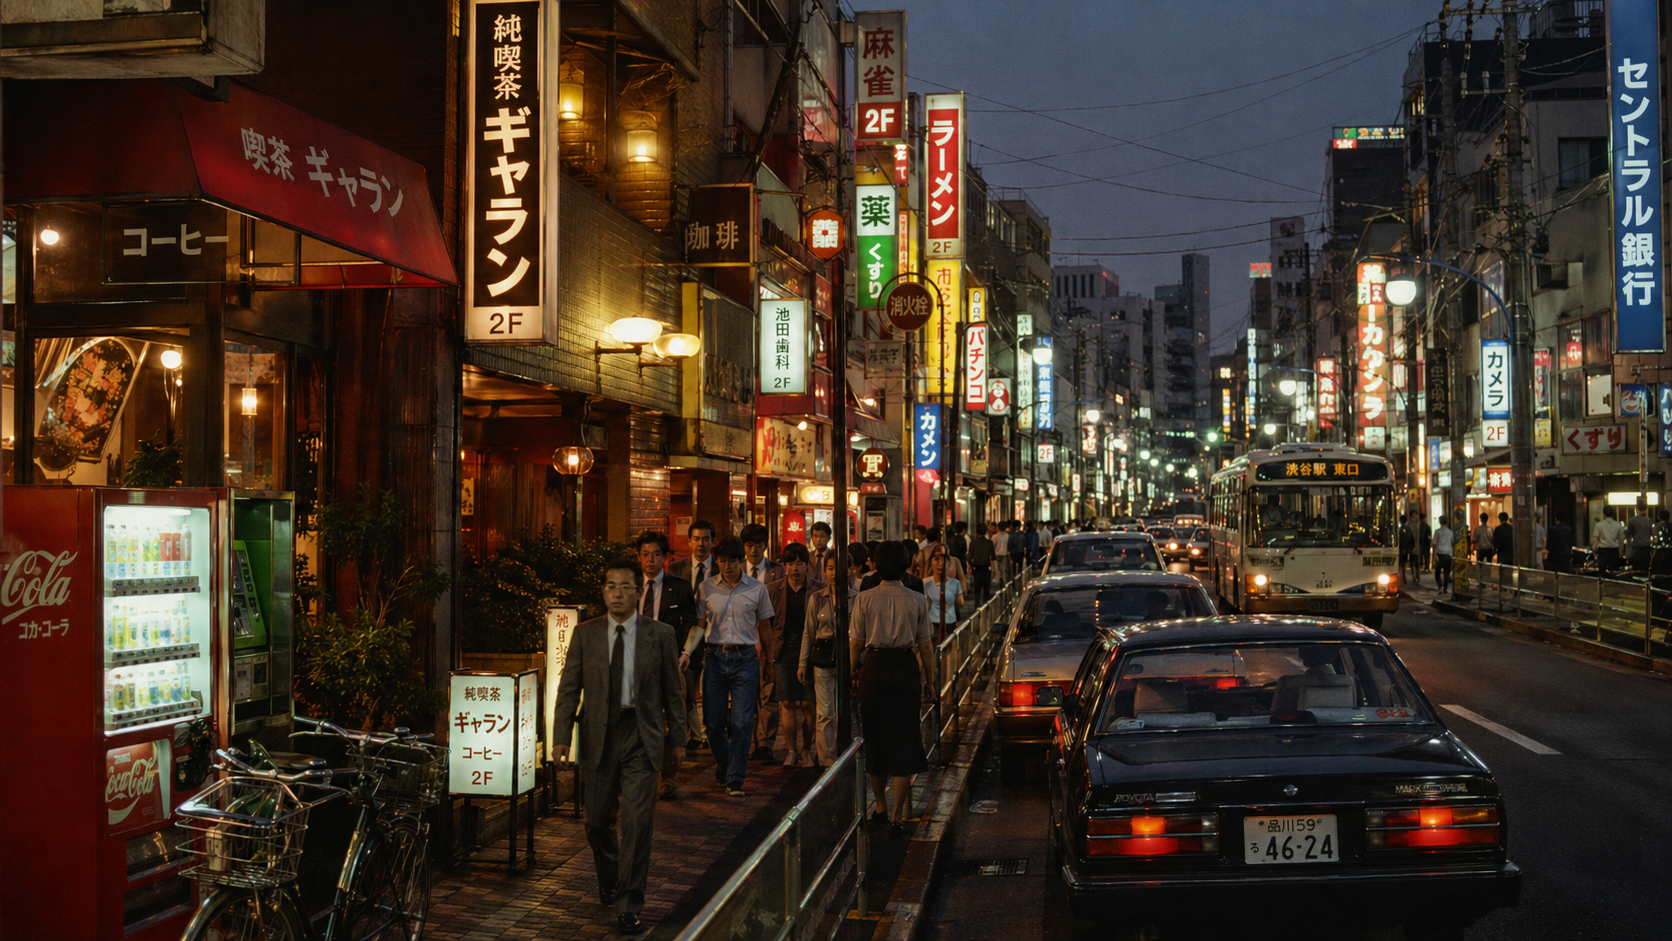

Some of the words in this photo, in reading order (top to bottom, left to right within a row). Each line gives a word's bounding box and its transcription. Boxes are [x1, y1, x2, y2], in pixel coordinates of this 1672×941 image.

[493, 14, 523, 100] 純喫茶
[862, 27, 895, 97] 麻雀
[865, 108, 895, 133] 2F
[241, 127, 295, 182] 喫茶
[305, 145, 403, 217] ギャラン
[931, 120, 955, 226] ラーメン
[1618, 58, 1655, 306] セントラル銀行
[484, 106, 531, 297] ギャラン
[861, 195, 890, 227] 薬
[123, 224, 229, 256] コーヒー
[688, 221, 739, 250] 珈琲
[932, 242, 952, 253] 2F
[867, 243, 884, 299] くすり
[891, 295, 928, 316] 消火栓
[489, 313, 523, 334] 2F
[775, 307, 791, 370] 池田歯科
[969, 330, 984, 399] パチンコ
[1487, 351, 1504, 407] カメラ
[774, 377, 791, 388] 2F
[1486, 426, 1505, 441] 2F
[1039, 448, 1052, 460] 2F
[1333, 462, 1359, 476] 東口
[464, 686, 501, 702] 純喫茶
[454, 711, 511, 734] ギャラン
[462, 746, 502, 761] コーヒー
[471, 770, 493, 786] 2F
